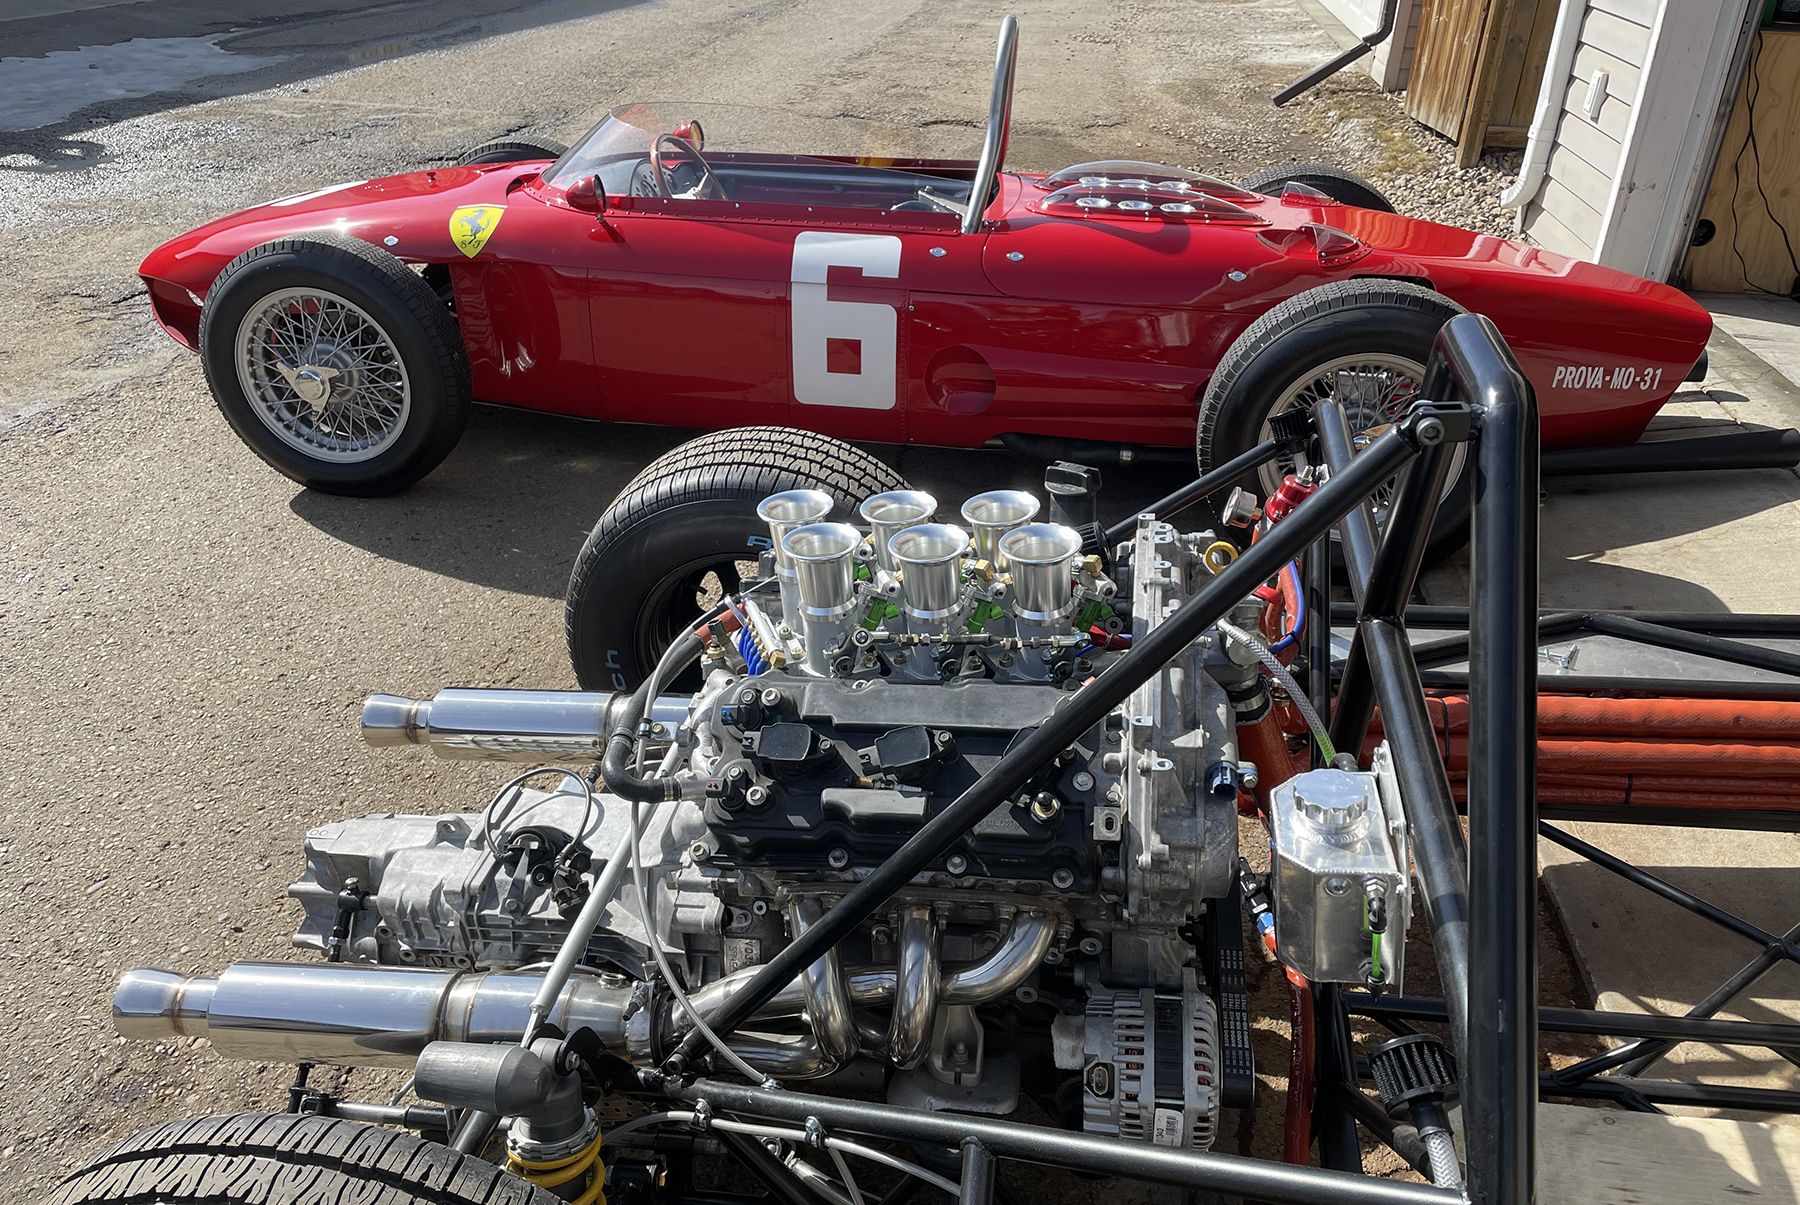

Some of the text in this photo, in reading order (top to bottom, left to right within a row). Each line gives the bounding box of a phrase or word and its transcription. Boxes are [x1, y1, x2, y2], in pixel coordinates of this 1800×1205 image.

[460, 239, 467, 249] S
[791, 231, 902, 410] 6
[1552, 366, 1662, 390] PROVA-MO-31
